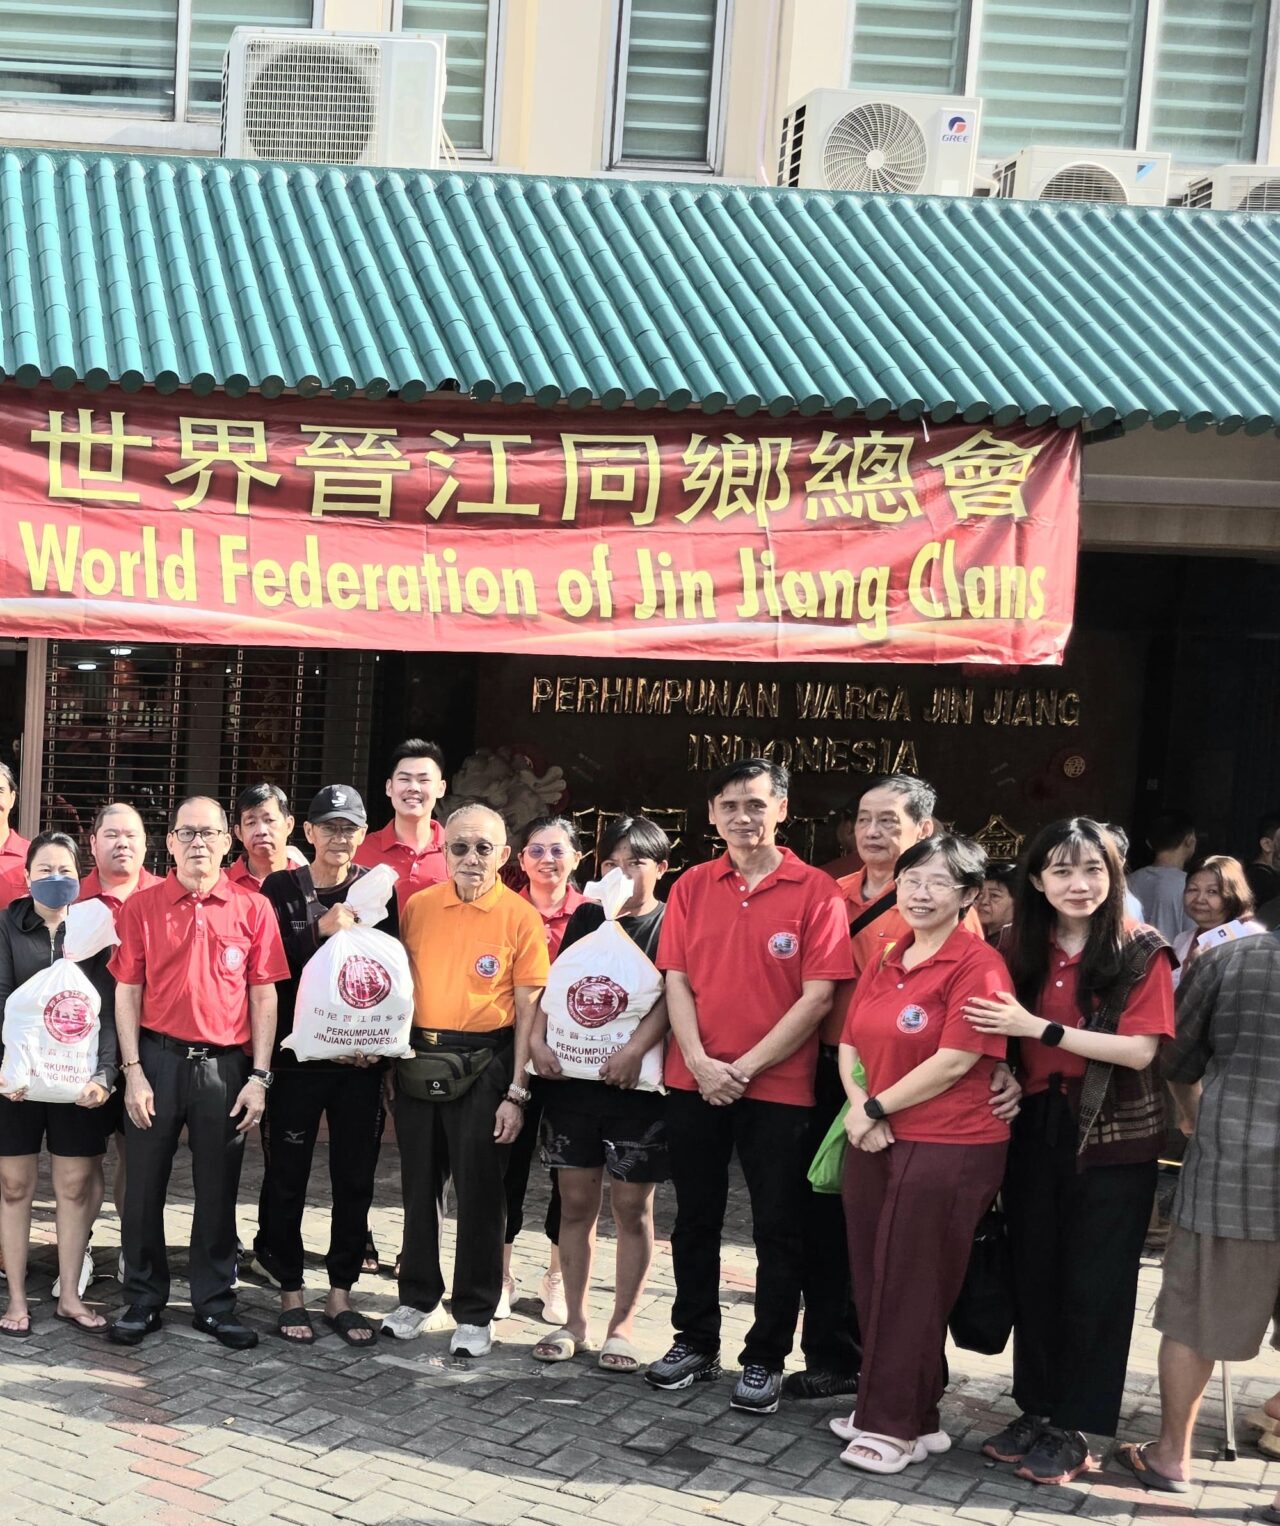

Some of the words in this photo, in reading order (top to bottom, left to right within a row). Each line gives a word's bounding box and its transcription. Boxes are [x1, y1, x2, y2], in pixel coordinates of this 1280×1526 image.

[942, 134, 969, 143] GREE
[31, 408, 1044, 528] 世界晉江同鄉總會
[18, 521, 198, 601] World
[220, 534, 538, 616] Federation
[557, 544, 614, 618] of
[636, 546, 716, 619] Jin
[736, 547, 890, 641] Jiang
[908, 540, 1046, 620] Clans
[532, 676, 780, 718] PERHIMPUNAN
[796, 682, 912, 721] WARGA
[923, 687, 974, 725] JIN
[983, 687, 1081, 727] JIANG
[687, 734, 919, 775] INDONESIA
[313, 1032, 352, 1046] JINJIANG
[353, 1037, 398, 1046] INDONESIA
[326, 1026, 390, 1037] PERKUMPULAN
[556, 1041, 624, 1056] PERKUMPULAN
